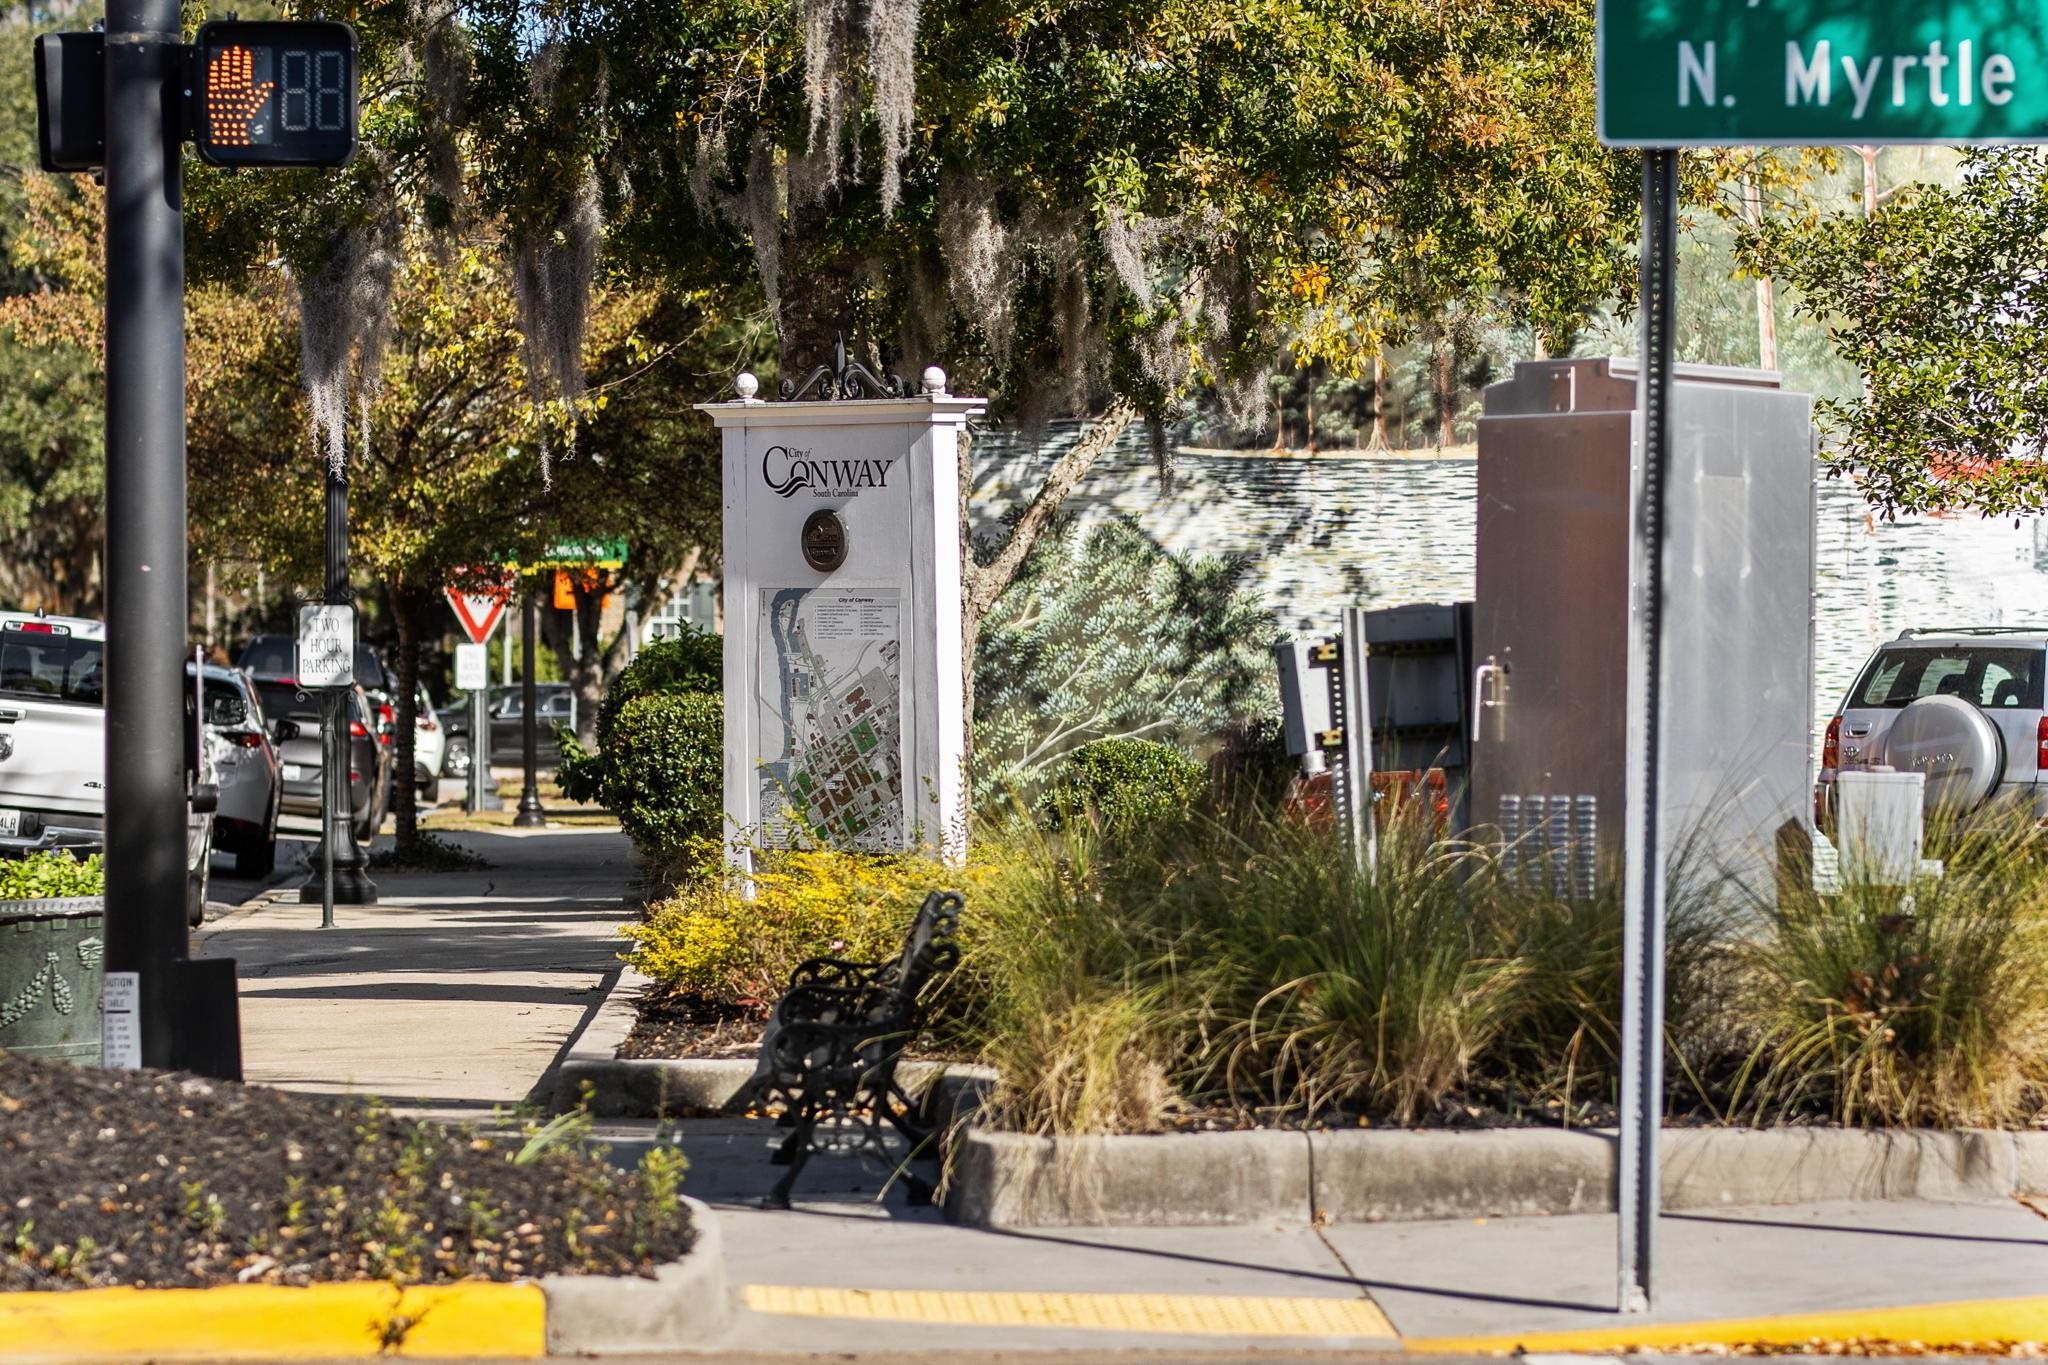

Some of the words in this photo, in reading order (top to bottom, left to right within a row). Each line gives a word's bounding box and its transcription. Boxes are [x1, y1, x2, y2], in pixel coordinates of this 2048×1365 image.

[1678, 40, 1736, 107] N.
[1785, 38, 2016, 120] Myrtle
[788, 447, 803, 460] City
[804, 447, 813, 460] of
[813, 488, 831, 498] South
[832, 488, 859, 498] Carolina
[313, 617, 340, 633] TWO
[310, 638, 342, 653] HOUR
[302, 658, 351, 674] PARKING
[103, 977, 132, 987] AUTION
